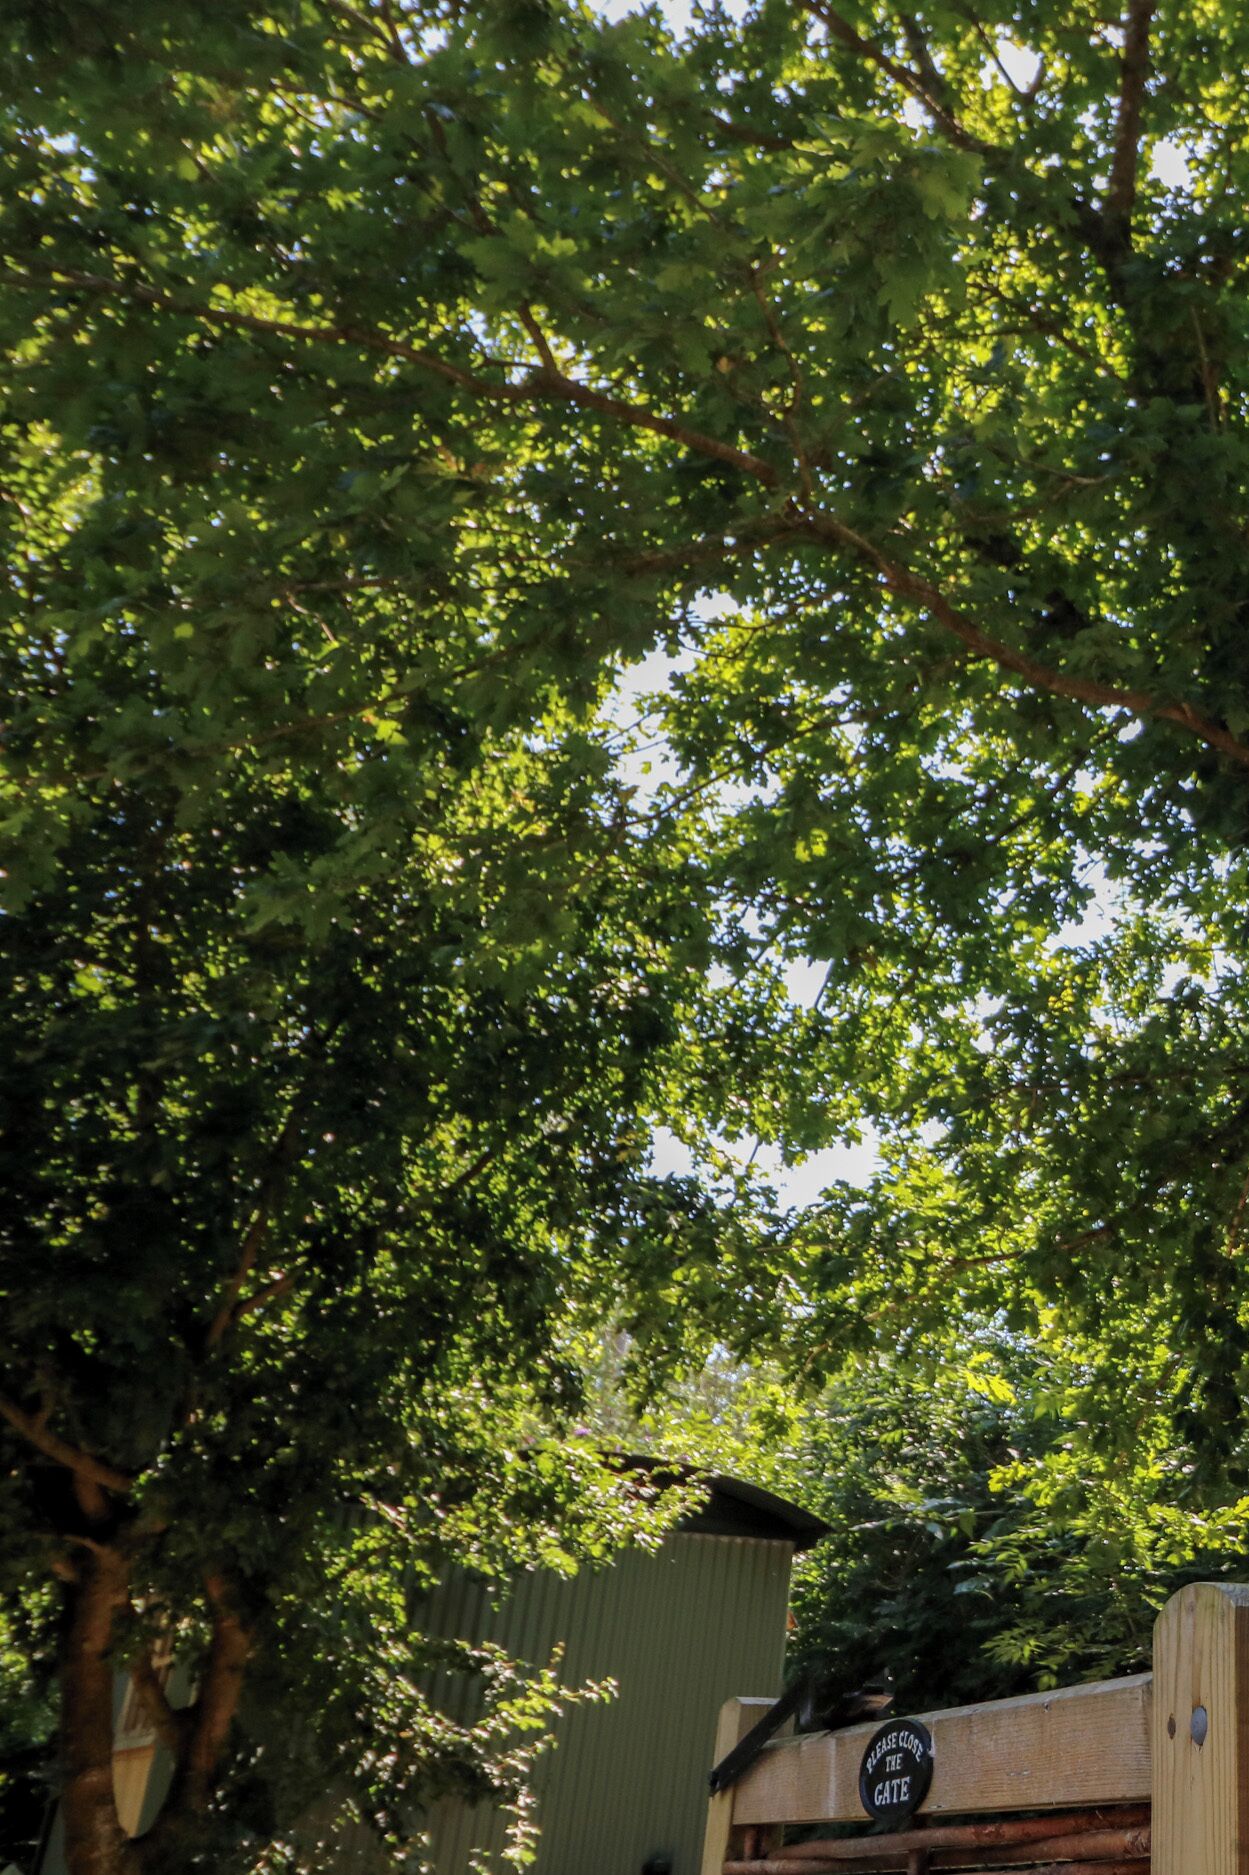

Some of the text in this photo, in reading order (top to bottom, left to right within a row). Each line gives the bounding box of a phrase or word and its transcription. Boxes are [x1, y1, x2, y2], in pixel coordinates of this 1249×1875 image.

[866, 1730, 923, 1774] PLEASE CLOSE
[885, 1753, 903, 1772] THE
[874, 1776, 910, 1806] GATE
